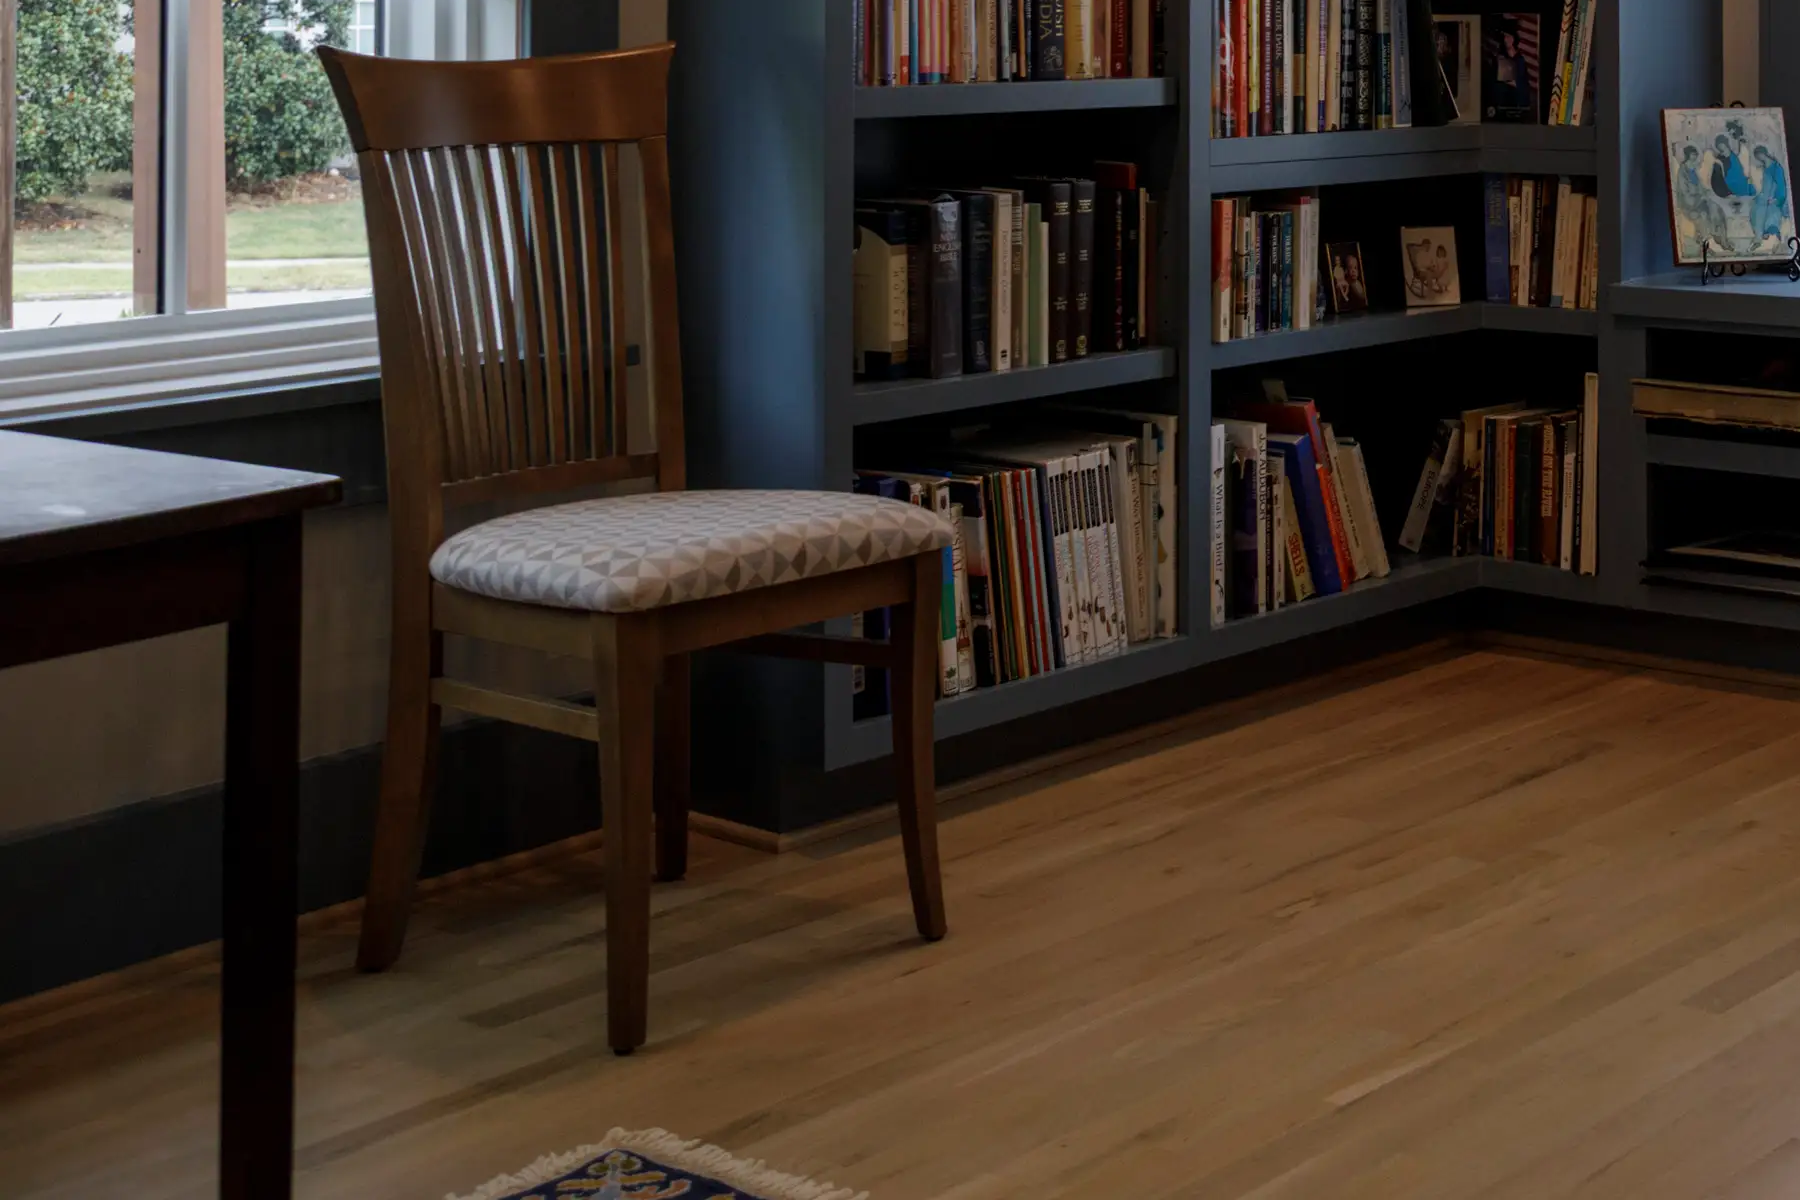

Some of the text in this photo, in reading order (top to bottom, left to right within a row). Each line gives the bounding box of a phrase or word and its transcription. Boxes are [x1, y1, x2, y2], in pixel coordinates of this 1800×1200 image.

[1275, 0, 1284, 61] OUTER DARK
[1271, 234, 1279, 265] TOLKIEN
[1258, 458, 1267, 522] AUDUBON
[1415, 469, 1436, 511] EUROPE
[1541, 469, 1553, 487] THE
[1214, 483, 1223, 516] What
[1540, 488, 1553, 517] RIVER
[1133, 520, 1143, 554] THINGS
[1214, 541, 1223, 574] Bird?
[1286, 531, 1305, 578] SHELLS
